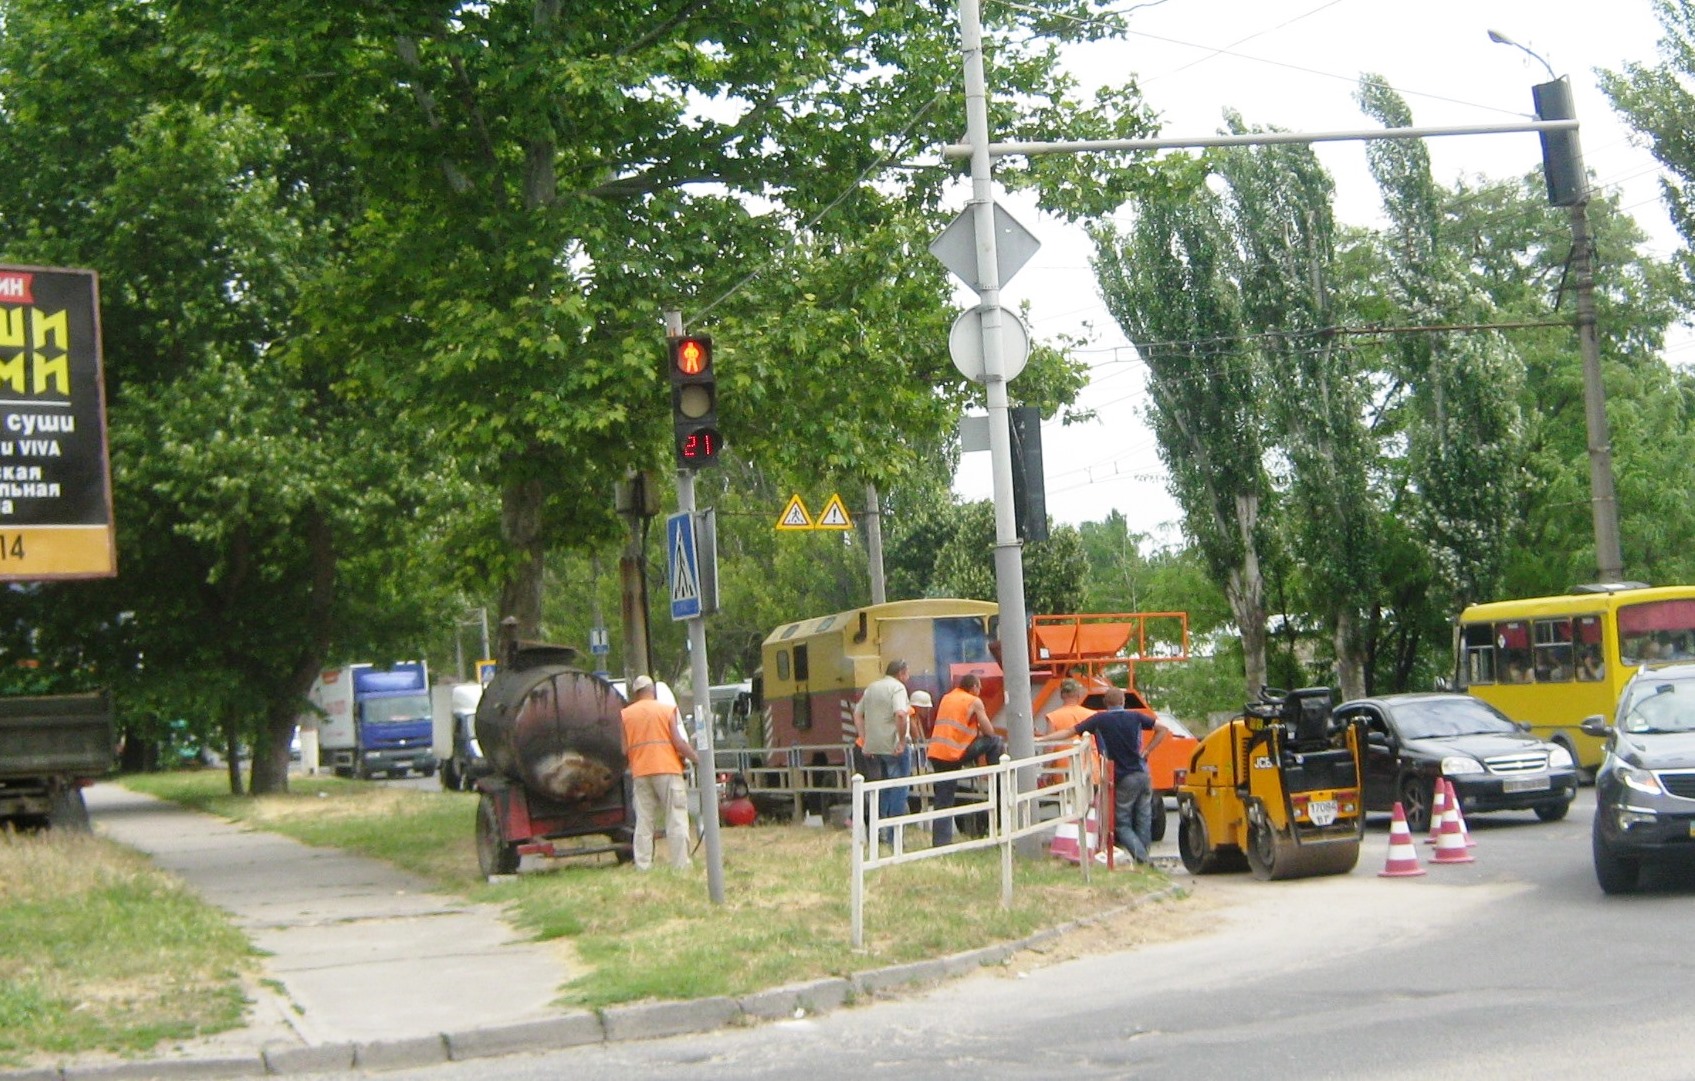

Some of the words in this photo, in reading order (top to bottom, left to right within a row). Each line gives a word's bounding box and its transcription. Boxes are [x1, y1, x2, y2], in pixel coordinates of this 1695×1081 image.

[7, 413, 75, 436] суши
[19, 440, 61, 457] VIVA
[684, 434, 711, 456] 21
[0, 465, 42, 480] кая
